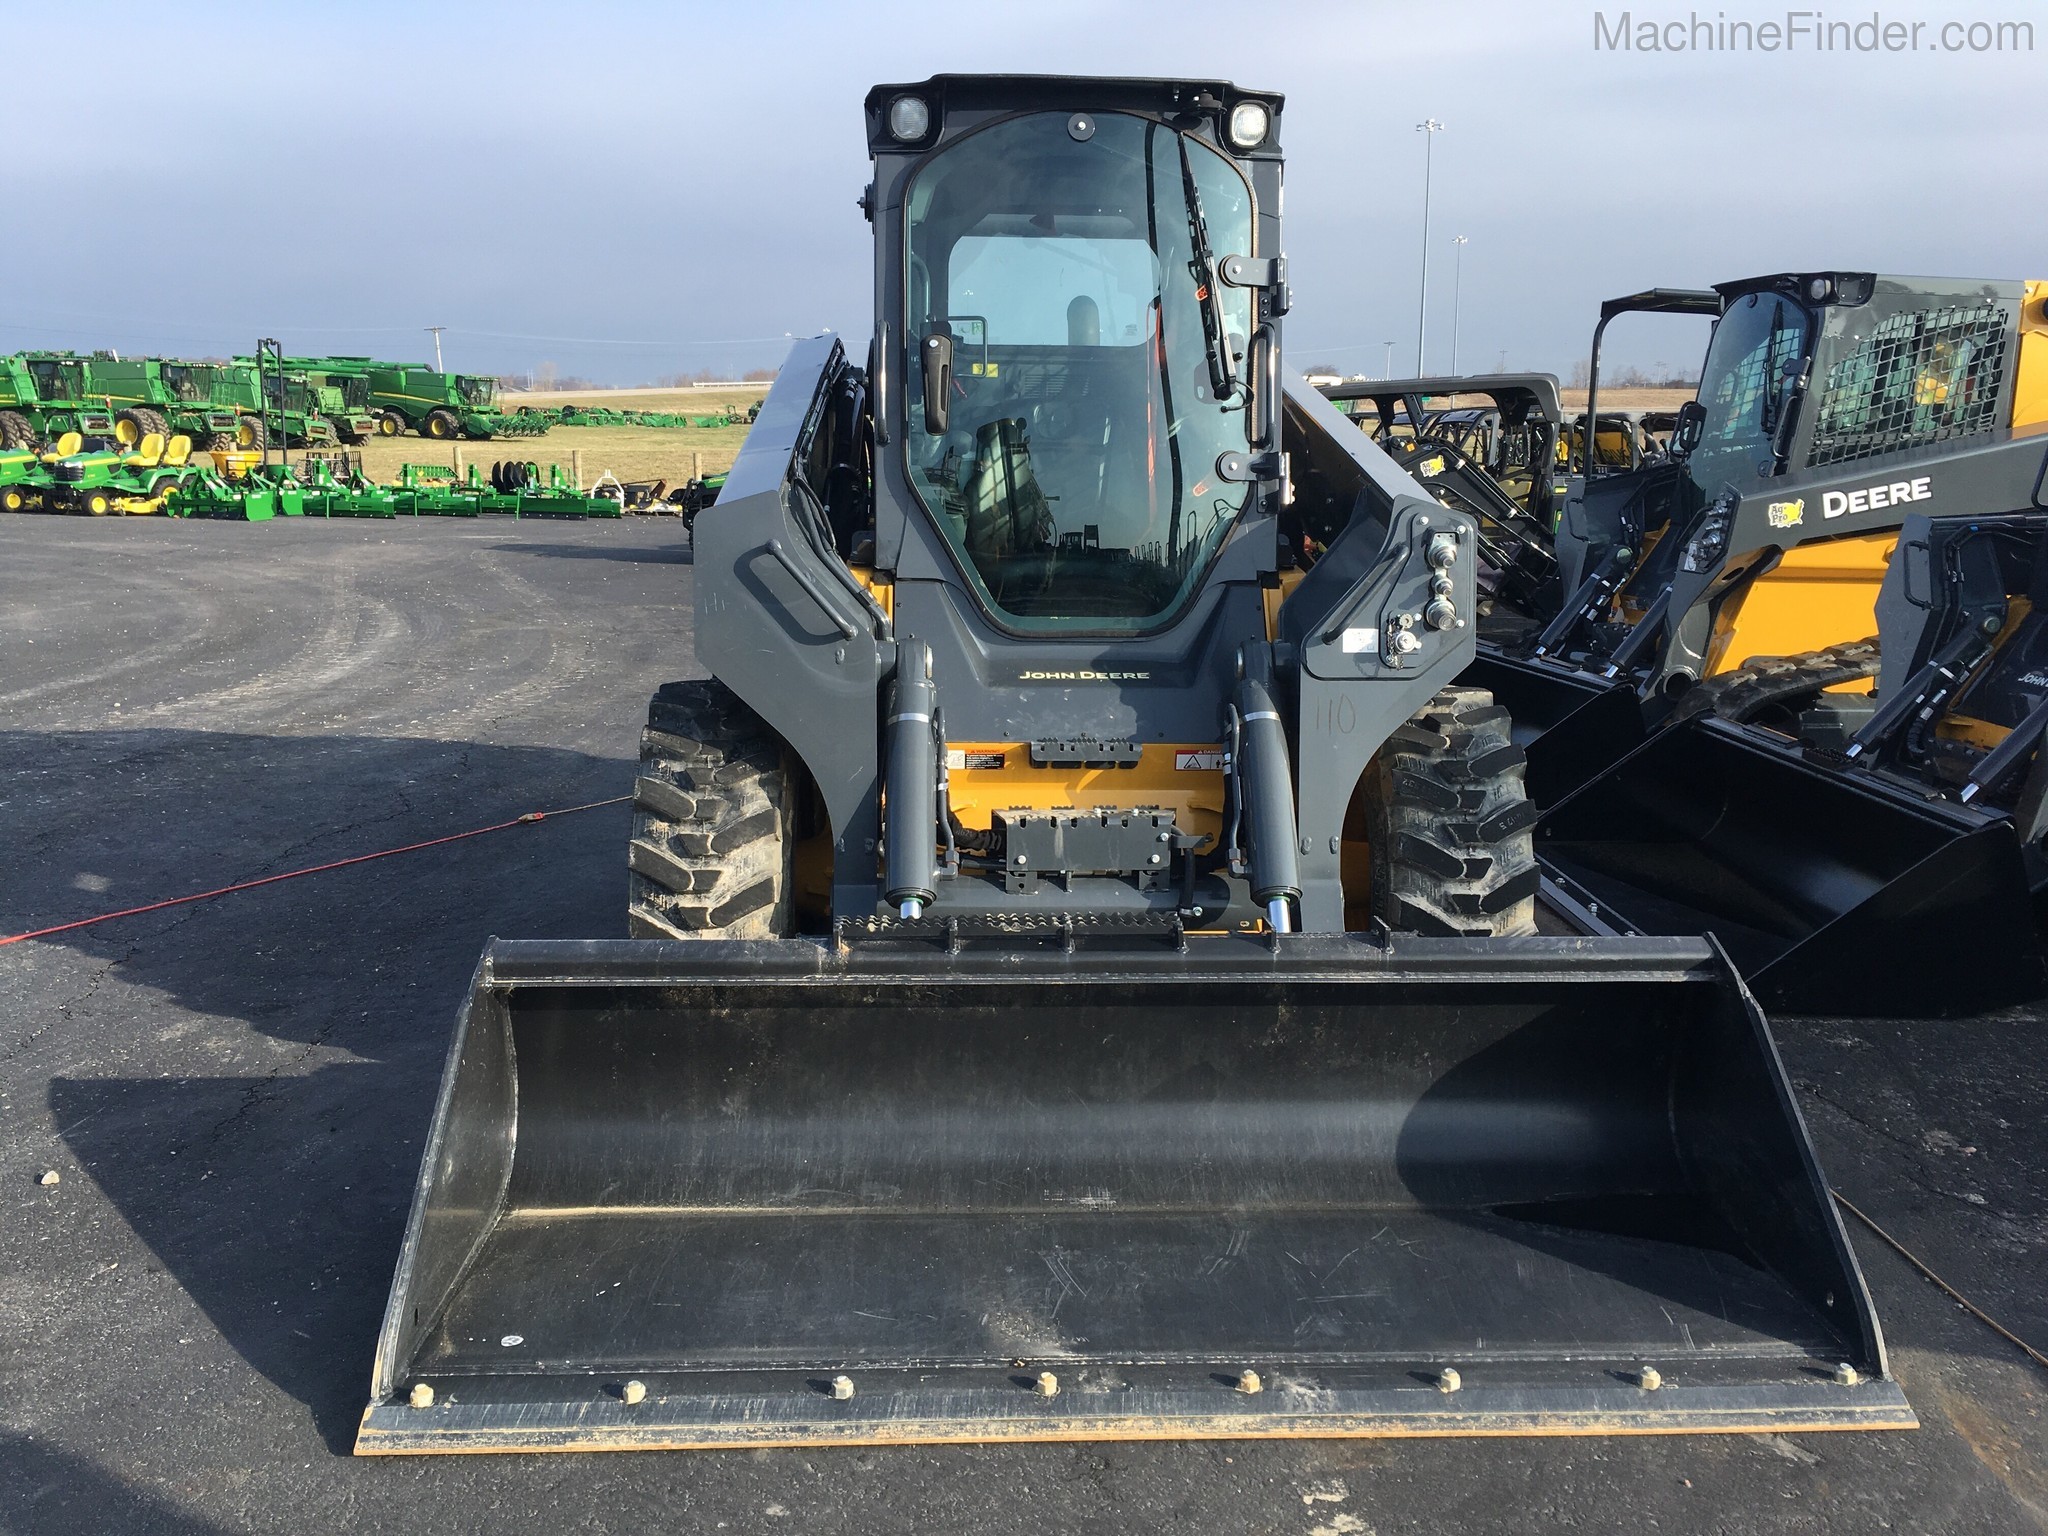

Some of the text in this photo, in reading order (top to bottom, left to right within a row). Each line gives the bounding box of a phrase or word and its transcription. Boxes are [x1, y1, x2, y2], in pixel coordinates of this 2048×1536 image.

[1821, 476, 1932, 519] DEERE
[1772, 513, 1788, 523] Pro
[1019, 671, 1150, 680] JOHN DEERE
[1315, 693, 1357, 737] 110
